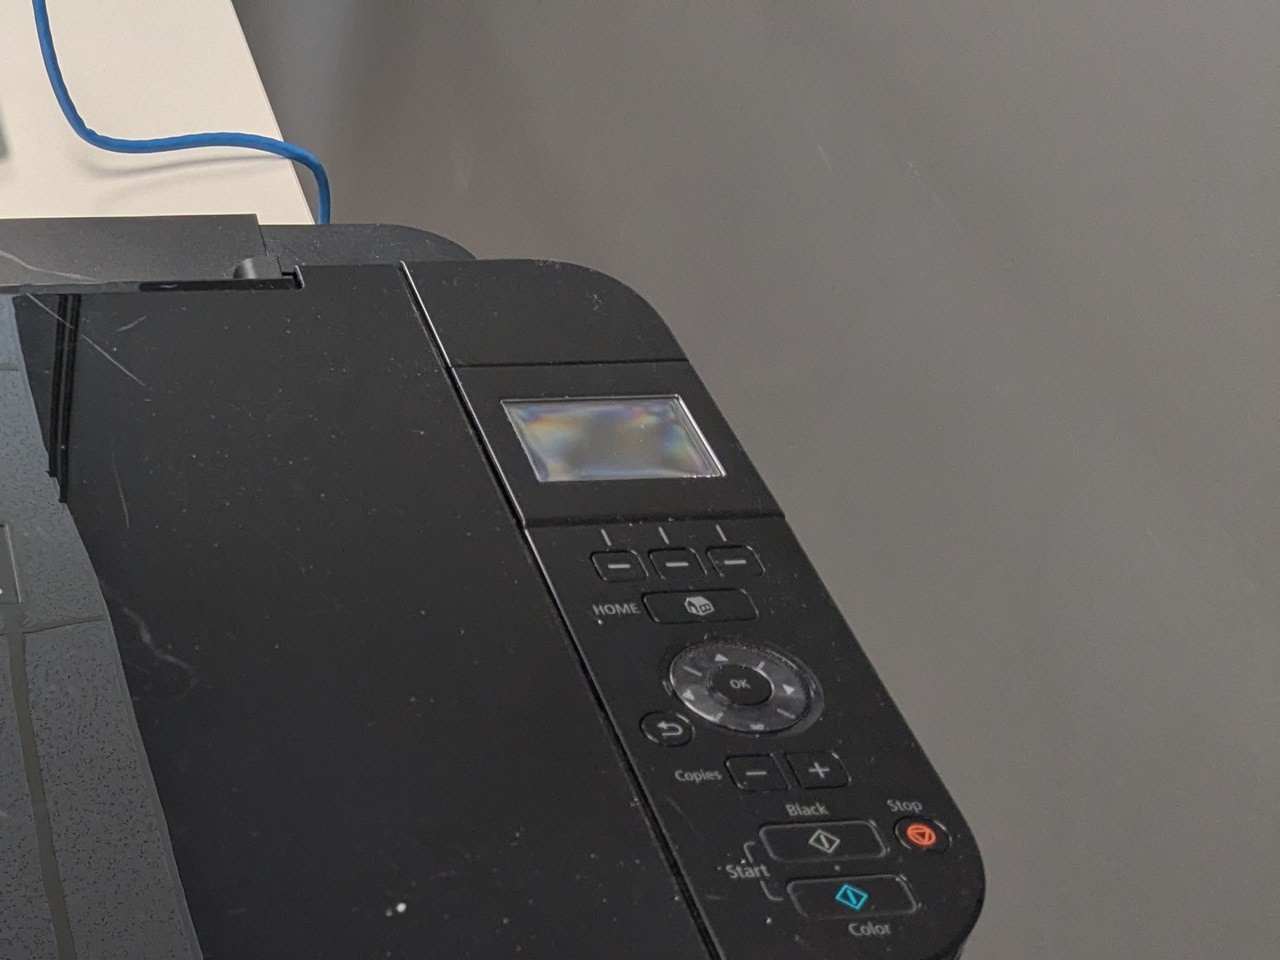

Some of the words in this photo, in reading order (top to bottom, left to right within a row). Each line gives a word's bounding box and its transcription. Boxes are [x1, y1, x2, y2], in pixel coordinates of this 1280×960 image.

[593, 603, 641, 616] HOME
[731, 678, 751, 690] OK
[675, 770, 722, 783] Copies
[786, 803, 830, 817] Black
[887, 800, 923, 813] Stop
[726, 864, 770, 880] Start
[848, 923, 891, 937] Color
